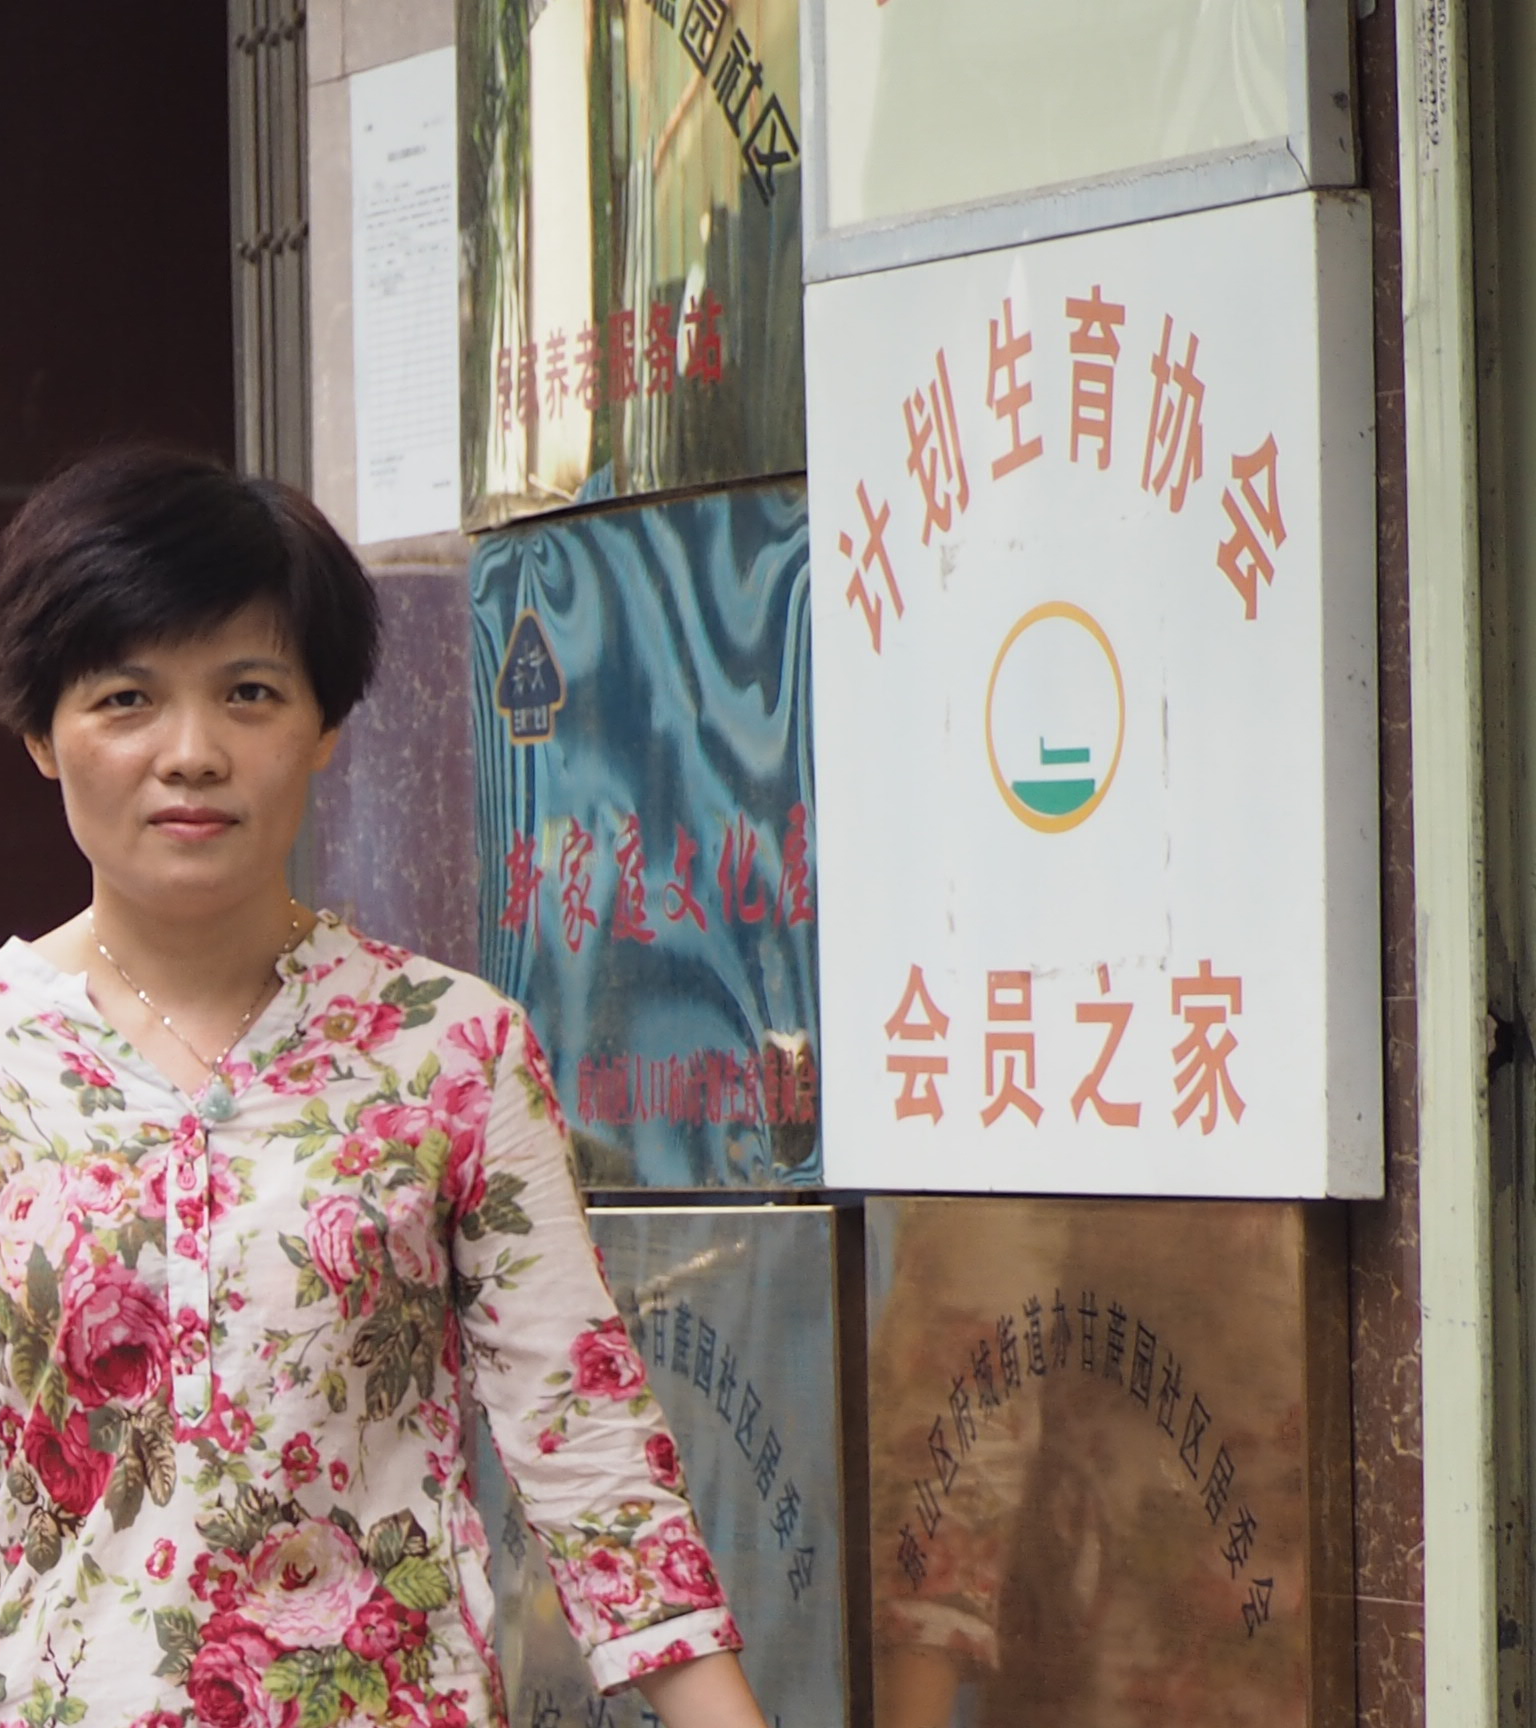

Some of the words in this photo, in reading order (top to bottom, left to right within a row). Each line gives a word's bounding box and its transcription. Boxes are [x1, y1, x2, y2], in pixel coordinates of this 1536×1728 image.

[838, 284, 1287, 656] 计划生育协会
[498, 802, 815, 952] 新家庭文化屋
[884, 958, 1247, 1136] 会员之家
